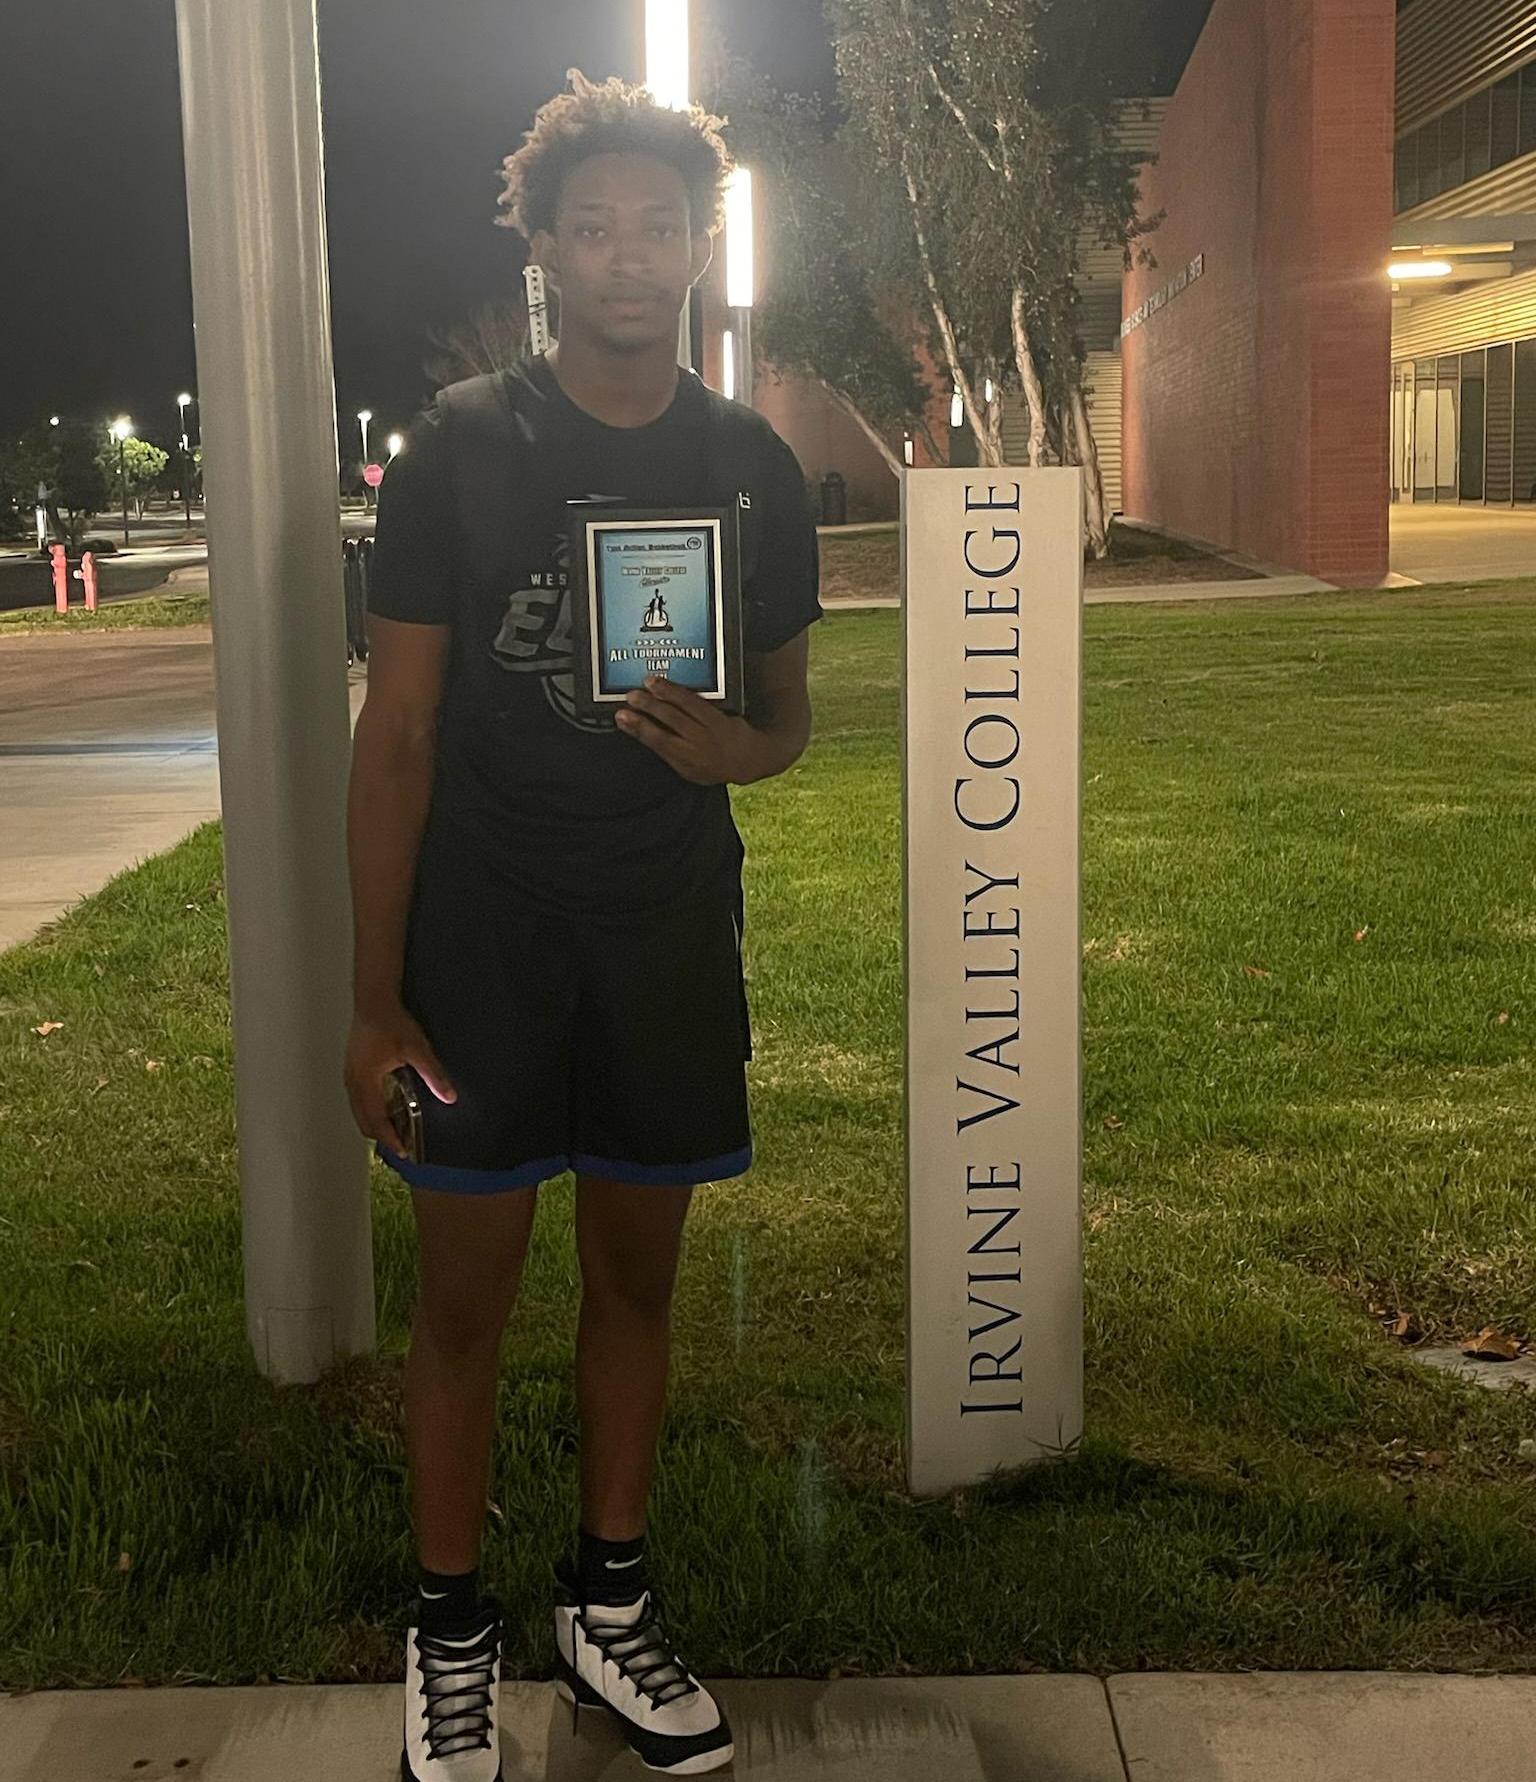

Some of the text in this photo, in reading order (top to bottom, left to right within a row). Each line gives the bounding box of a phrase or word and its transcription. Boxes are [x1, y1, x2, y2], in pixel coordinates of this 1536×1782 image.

[530, 573, 568, 586] WES
[609, 647, 705, 662] ALL TOURNAMENT
[954, 482, 1023, 1417] IRVINE VALLEY COLLEGE
